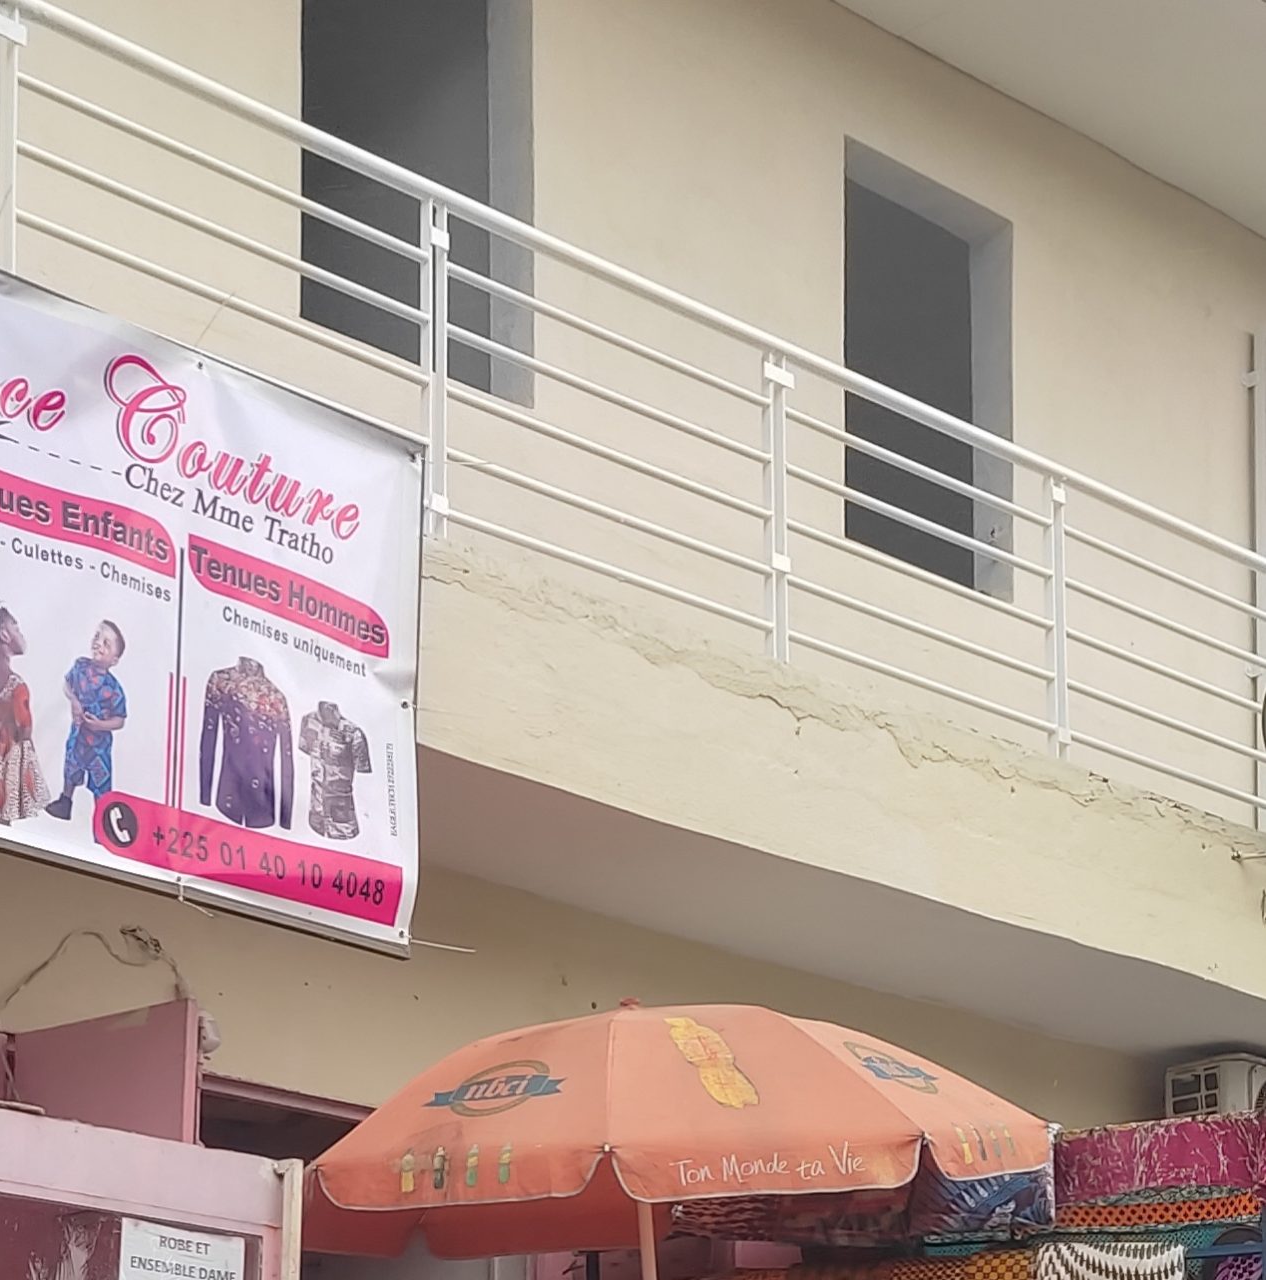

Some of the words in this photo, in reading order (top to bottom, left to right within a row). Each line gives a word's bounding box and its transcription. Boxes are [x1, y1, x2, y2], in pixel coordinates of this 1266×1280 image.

[103, 354, 361, 541] Couture
[62, 500, 168, 561] Enfants
[125, 463, 185, 508] Chez
[192, 488, 254, 534] Mme
[264, 516, 334, 564] Tratho
[100, 562, 172, 602] Chemises
[190, 545, 280, 602] Tenues
[288, 580, 385, 644] Hommes
[222, 606, 288, 645] Chemises
[293, 636, 367, 677] uniquement
[153, 826, 208, 862] +225
[220, 842, 246, 870] 01
[259, 852, 285, 880] 40
[298, 859, 322, 889] 10
[331, 869, 385, 906] 4048
[669, 1159, 715, 1186] Ton
[721, 1152, 790, 1183] Monde
[795, 1160, 825, 1180] ta
[828, 1141, 866, 1175] Vie
[130, 1256, 196, 1278] ENSEMBLE
[159, 1235, 194, 1252] ROBE
[196, 1242, 211, 1255] ET
